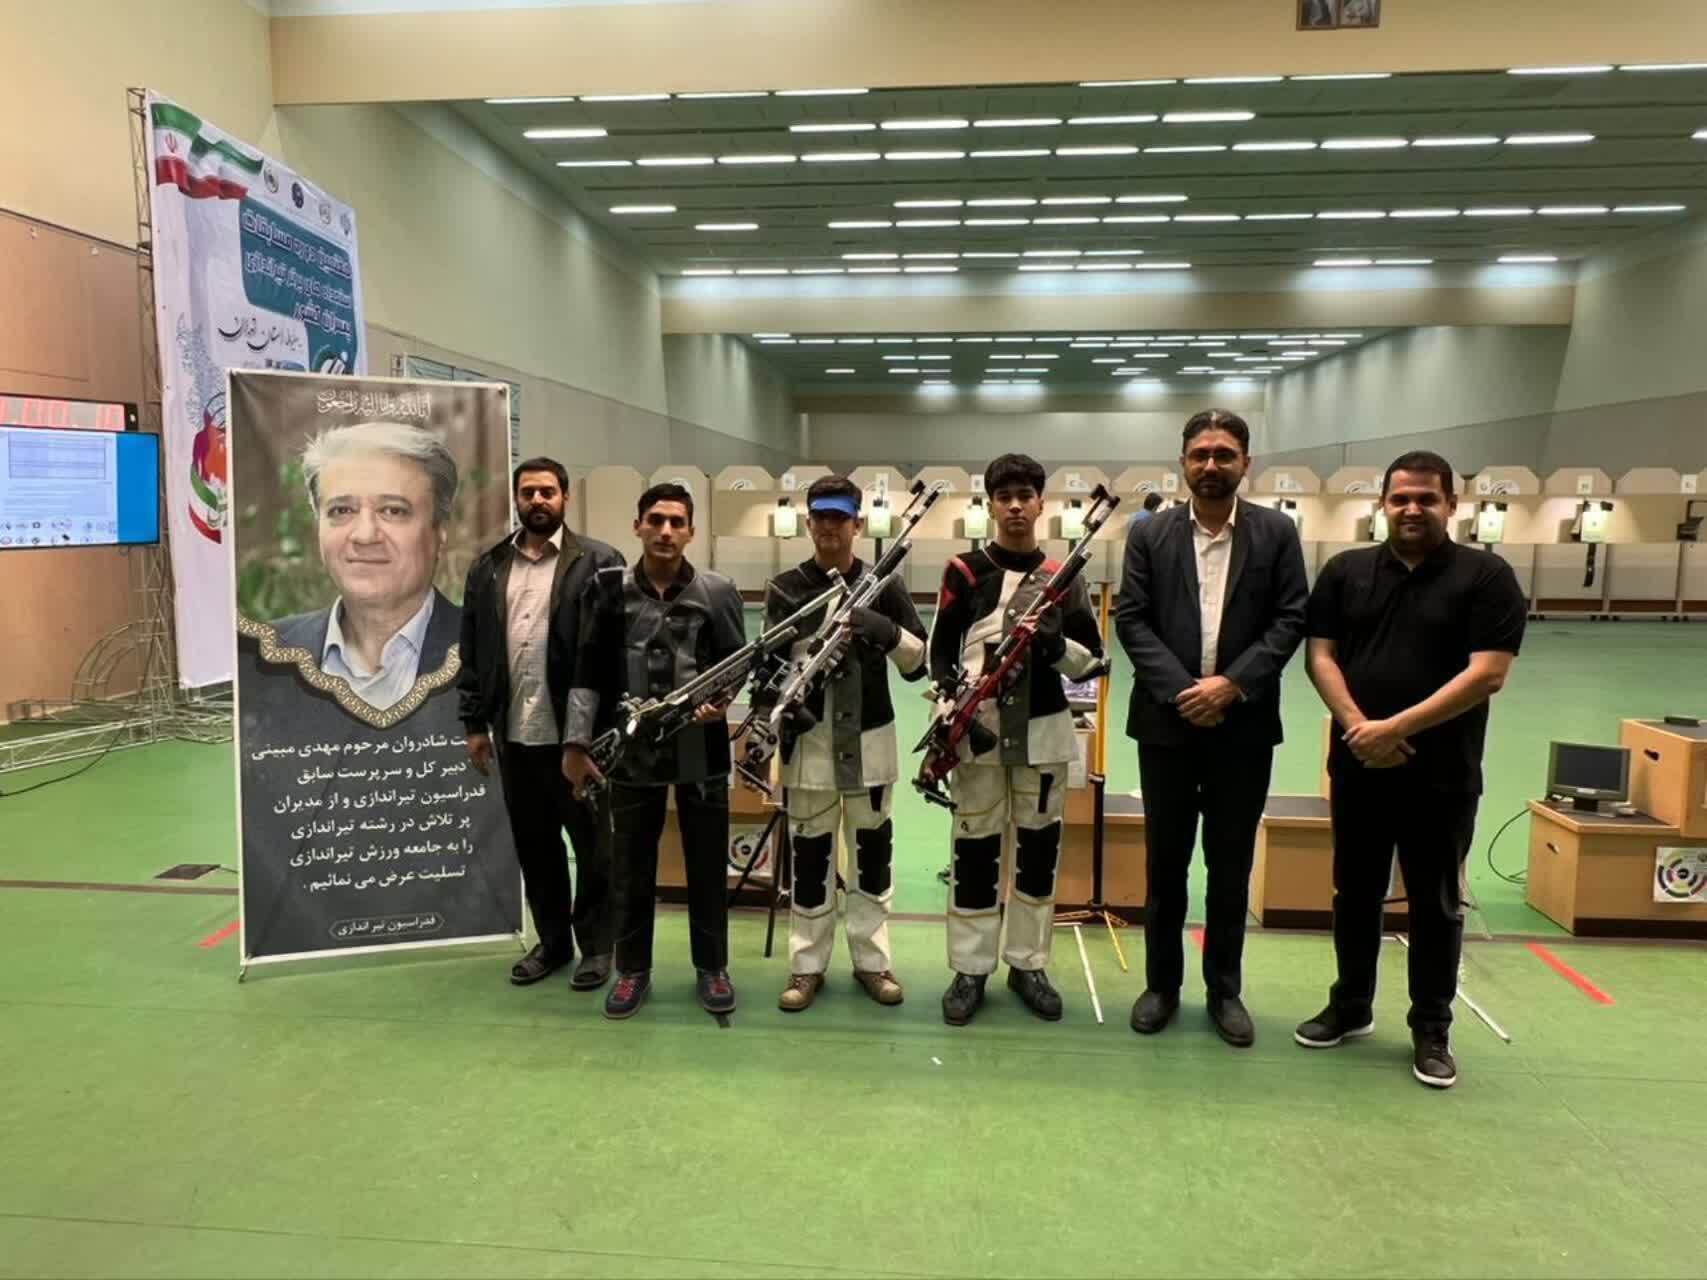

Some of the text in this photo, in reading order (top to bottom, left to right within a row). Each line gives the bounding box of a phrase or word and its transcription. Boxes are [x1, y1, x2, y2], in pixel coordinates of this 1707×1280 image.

[241, 208, 293, 251] مسابقات
[251, 745, 296, 761] مبینی
[298, 743, 341, 758] مهدی
[343, 741, 390, 756] مرحوم
[391, 734, 448, 754] شادروان
[296, 766, 335, 784] سابق
[405, 766, 413, 779] و
[415, 760, 437, 779] کل
[440, 760, 467, 778] دبیر
[272, 783, 487, 814] فدراسیون تیراندازی و از مدیران
[290, 812, 471, 840] پر تلاش در رشته تیراندازی
[289, 837, 474, 867] را به جامعه ورزش تیراندازی
[354, 874, 376, 890] می
[378, 869, 416, 888] عرض
[417, 865, 467, 882] تسلیت
[387, 913, 436, 932] فدراسیون
